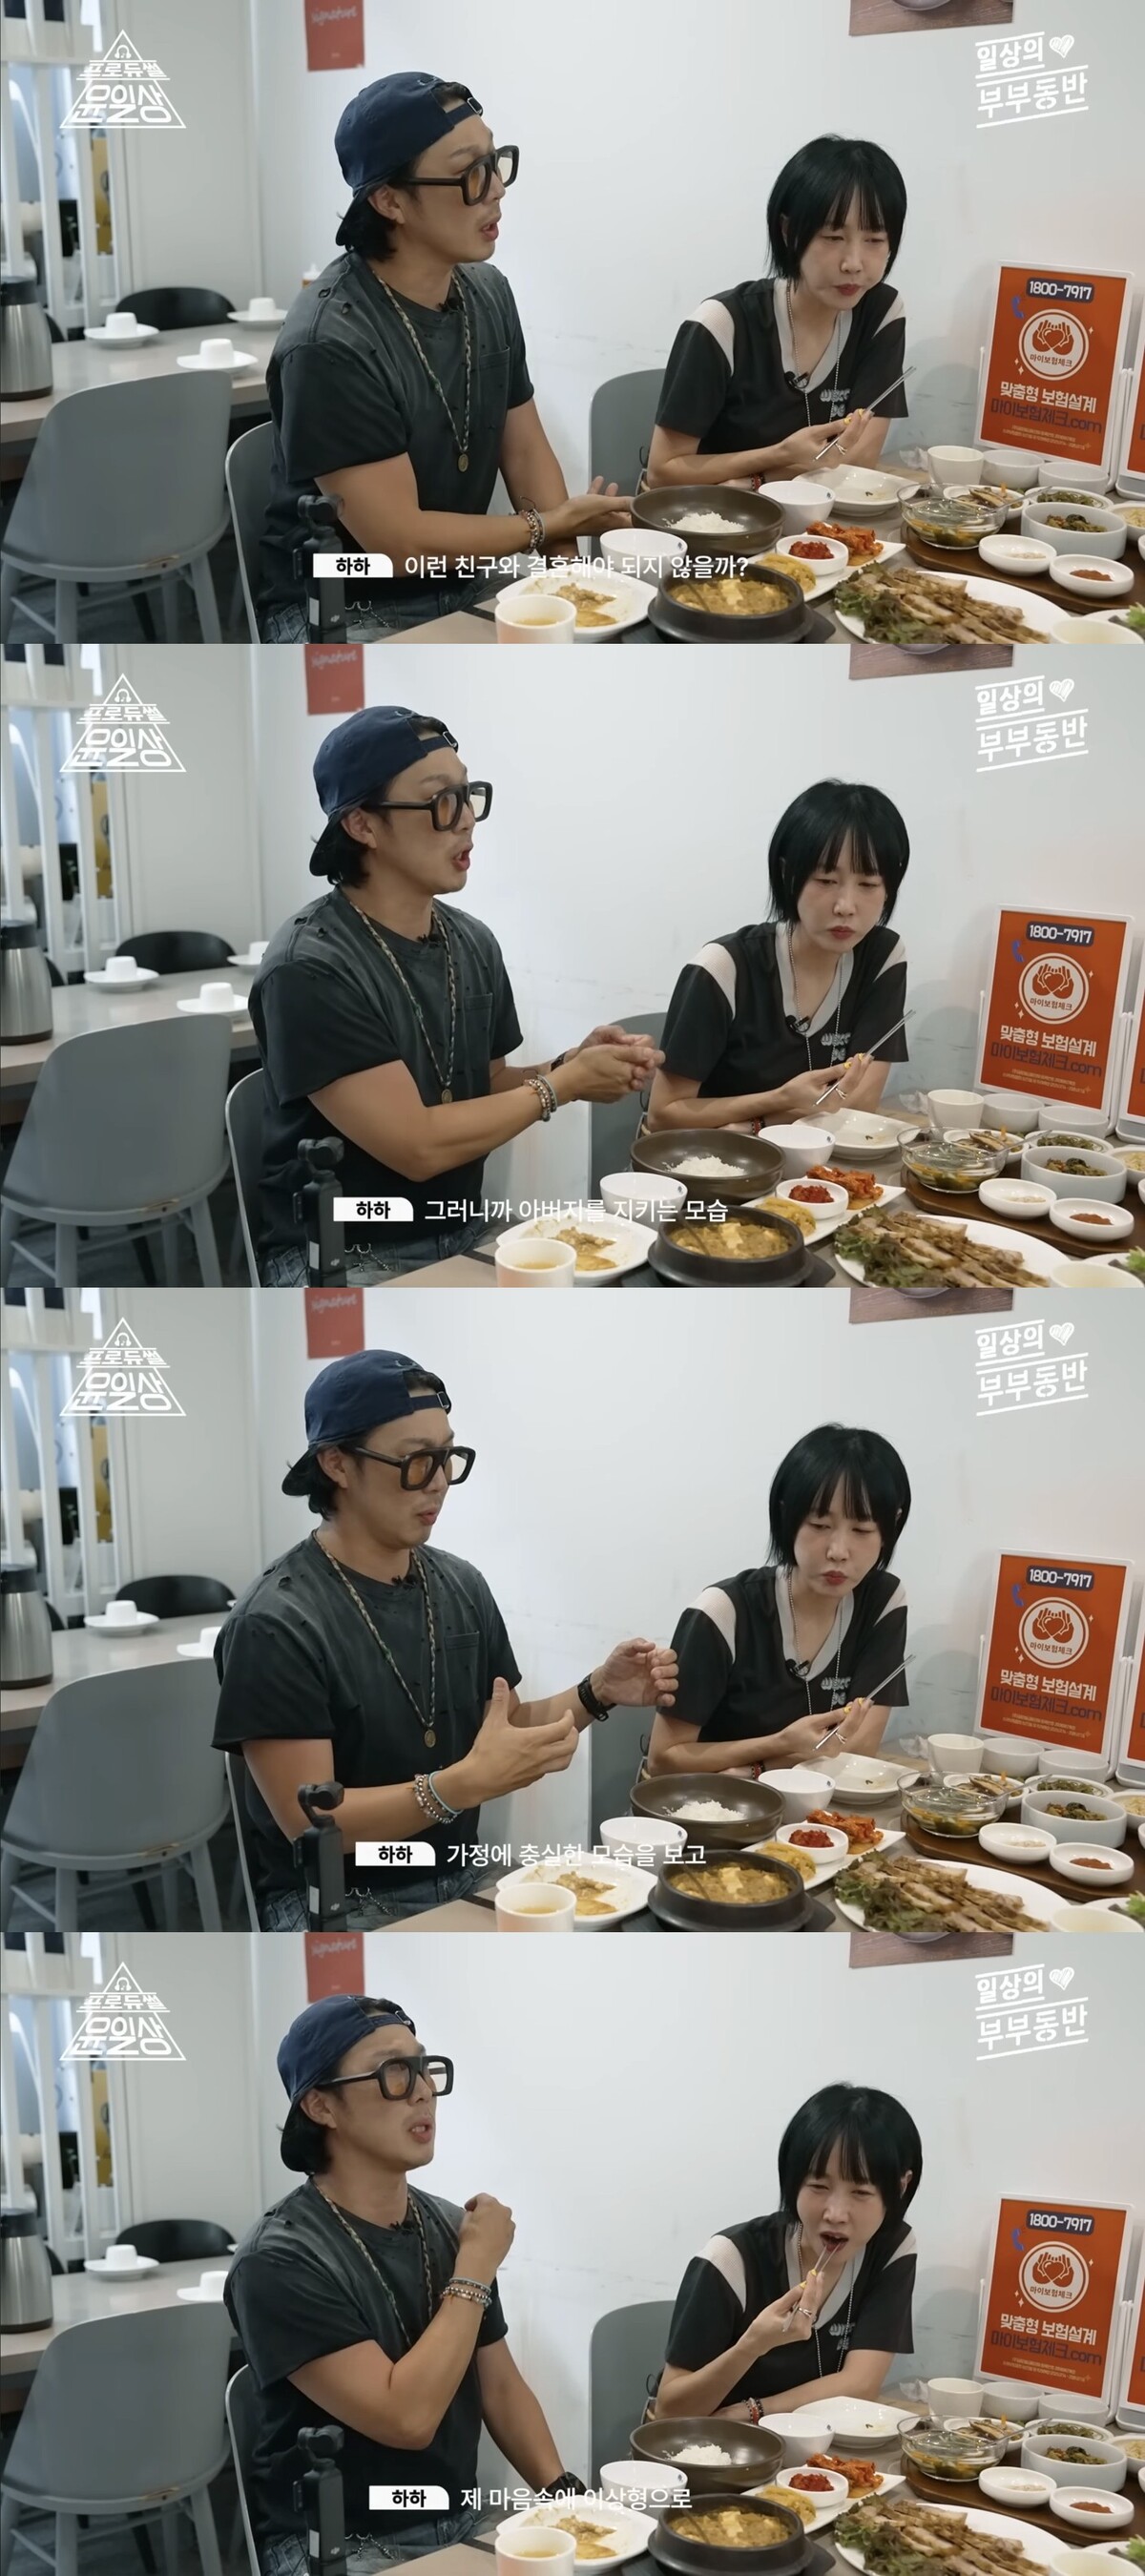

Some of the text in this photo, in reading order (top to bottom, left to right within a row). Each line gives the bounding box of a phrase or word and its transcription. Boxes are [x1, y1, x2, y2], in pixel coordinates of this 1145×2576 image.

[1029, 280, 1093, 300] 1800-7917
[1030, 354, 1072, 367] 마이보험체크
[1000, 381, 1097, 414] 맞춤형 보험설계
[990, 398, 1102, 434] 마이보험체크.com
[1029, 924, 1093, 944] 1800-7917
[1030, 998, 1072, 1011] 마이보험체크
[1000, 1025, 1097, 1058] 맞춤형 보험설계
[990, 1042, 1102, 1078] 마이보험체크.com
[1029, 1568, 1093, 1588] 1800-7917
[1030, 1642, 1072, 1655] 마이보험체크
[1000, 1669, 1097, 1702] 맞춤형 보험설계
[990, 1686, 1102, 1722] 마이보험체크.com
[1029, 2212, 1093, 2232] 1800-7917
[1030, 2286, 1072, 2299] 마이보험체크
[1000, 2313, 1097, 2346] 맞춤형 보험설계
[990, 2330, 1102, 2366] 마이보험체크.com
